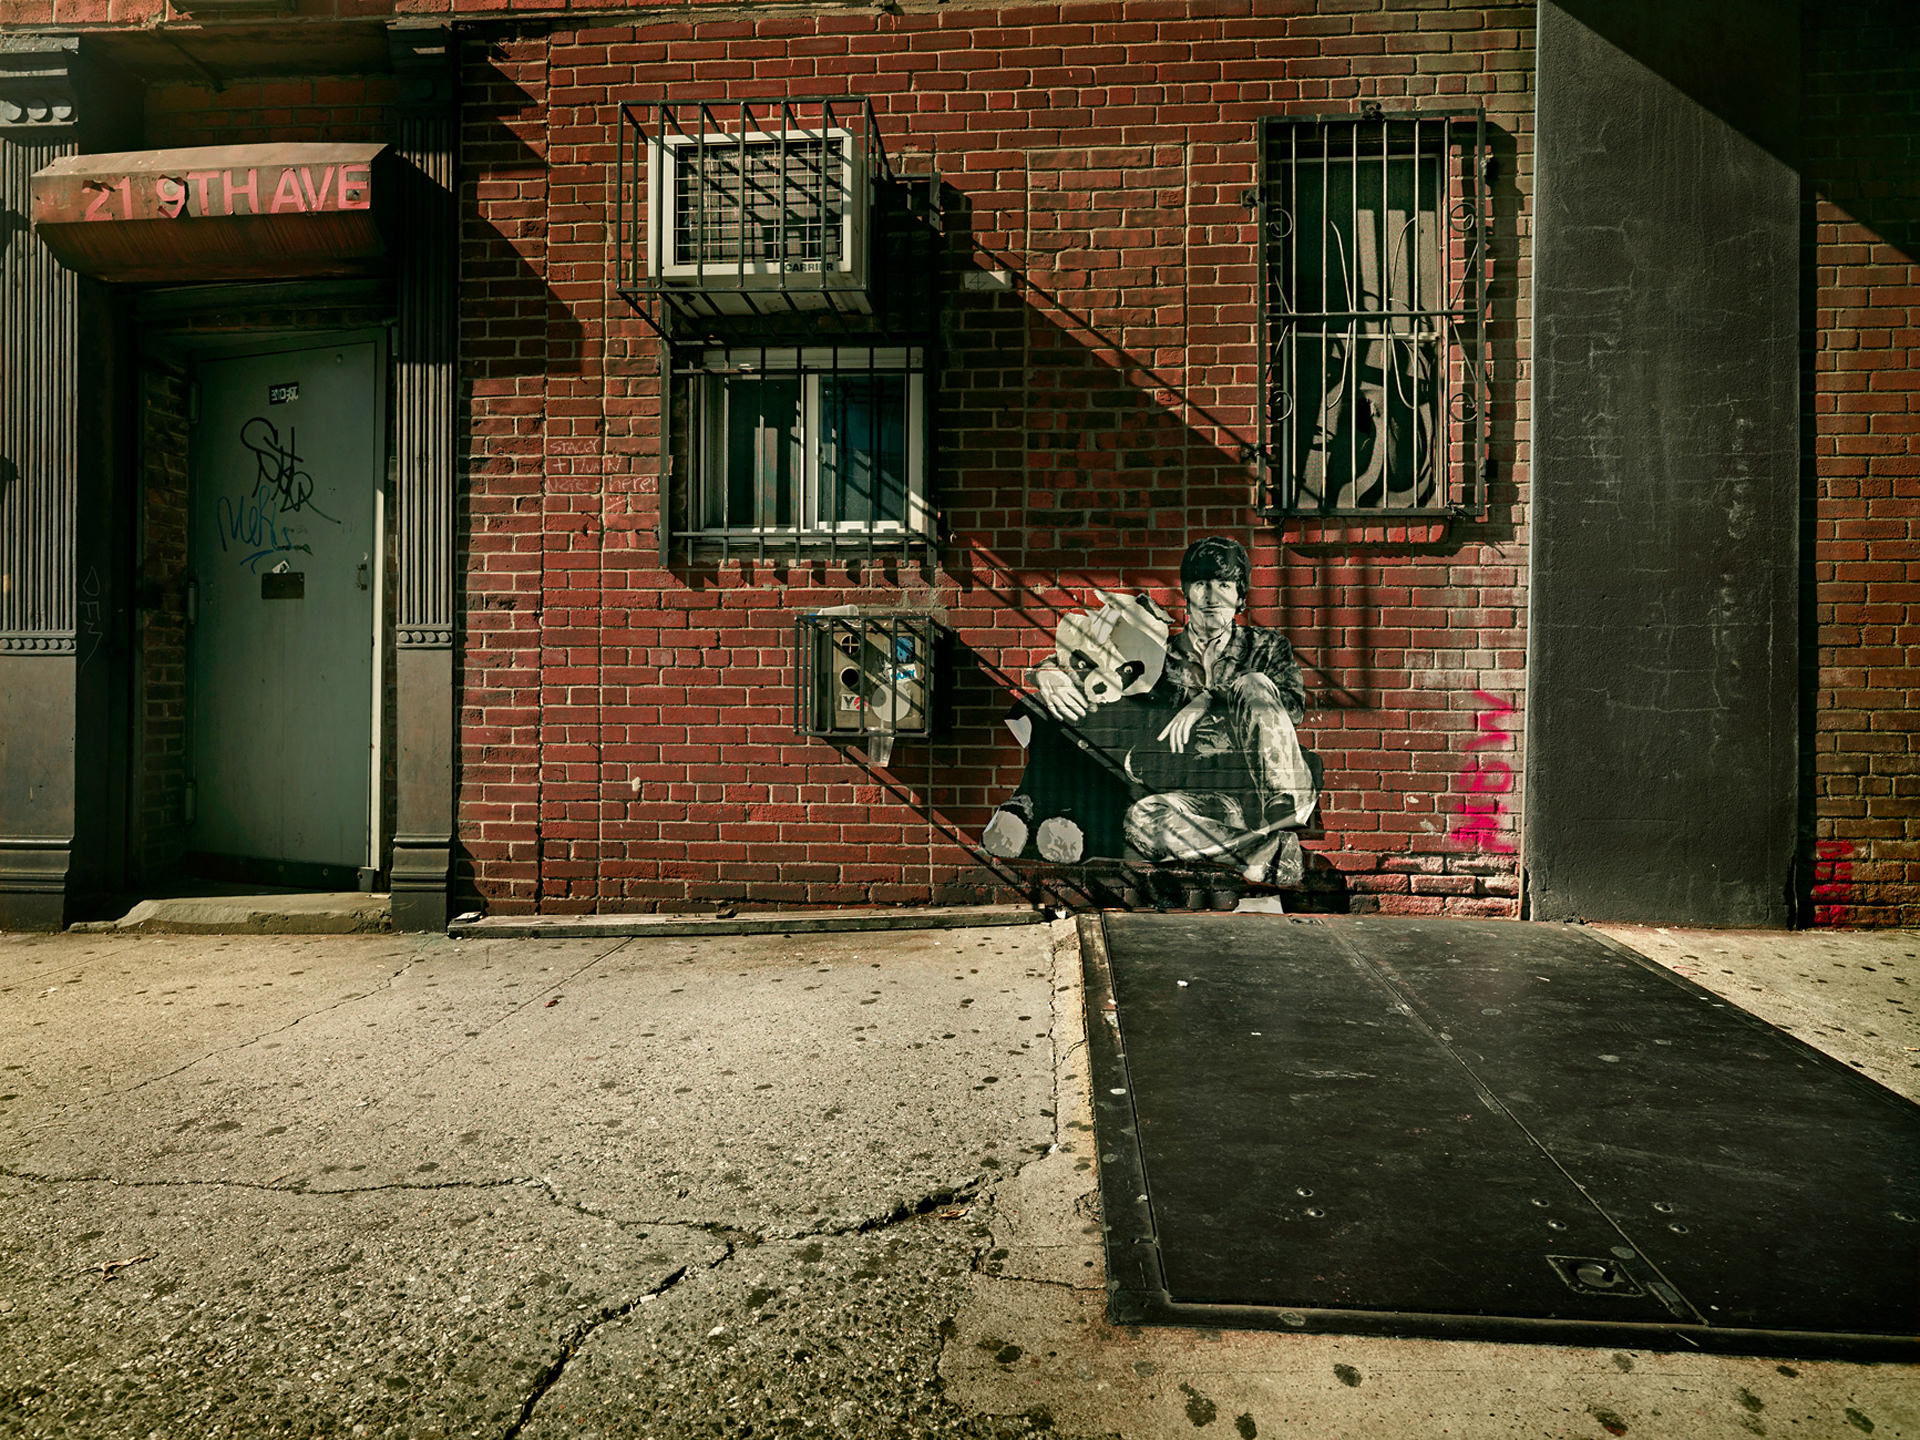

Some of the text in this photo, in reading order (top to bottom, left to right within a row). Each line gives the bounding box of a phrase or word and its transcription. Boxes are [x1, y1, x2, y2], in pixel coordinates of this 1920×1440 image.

[81, 164, 370, 221] 21 9TH AVE
[785, 263, 833, 272] CARRIR
